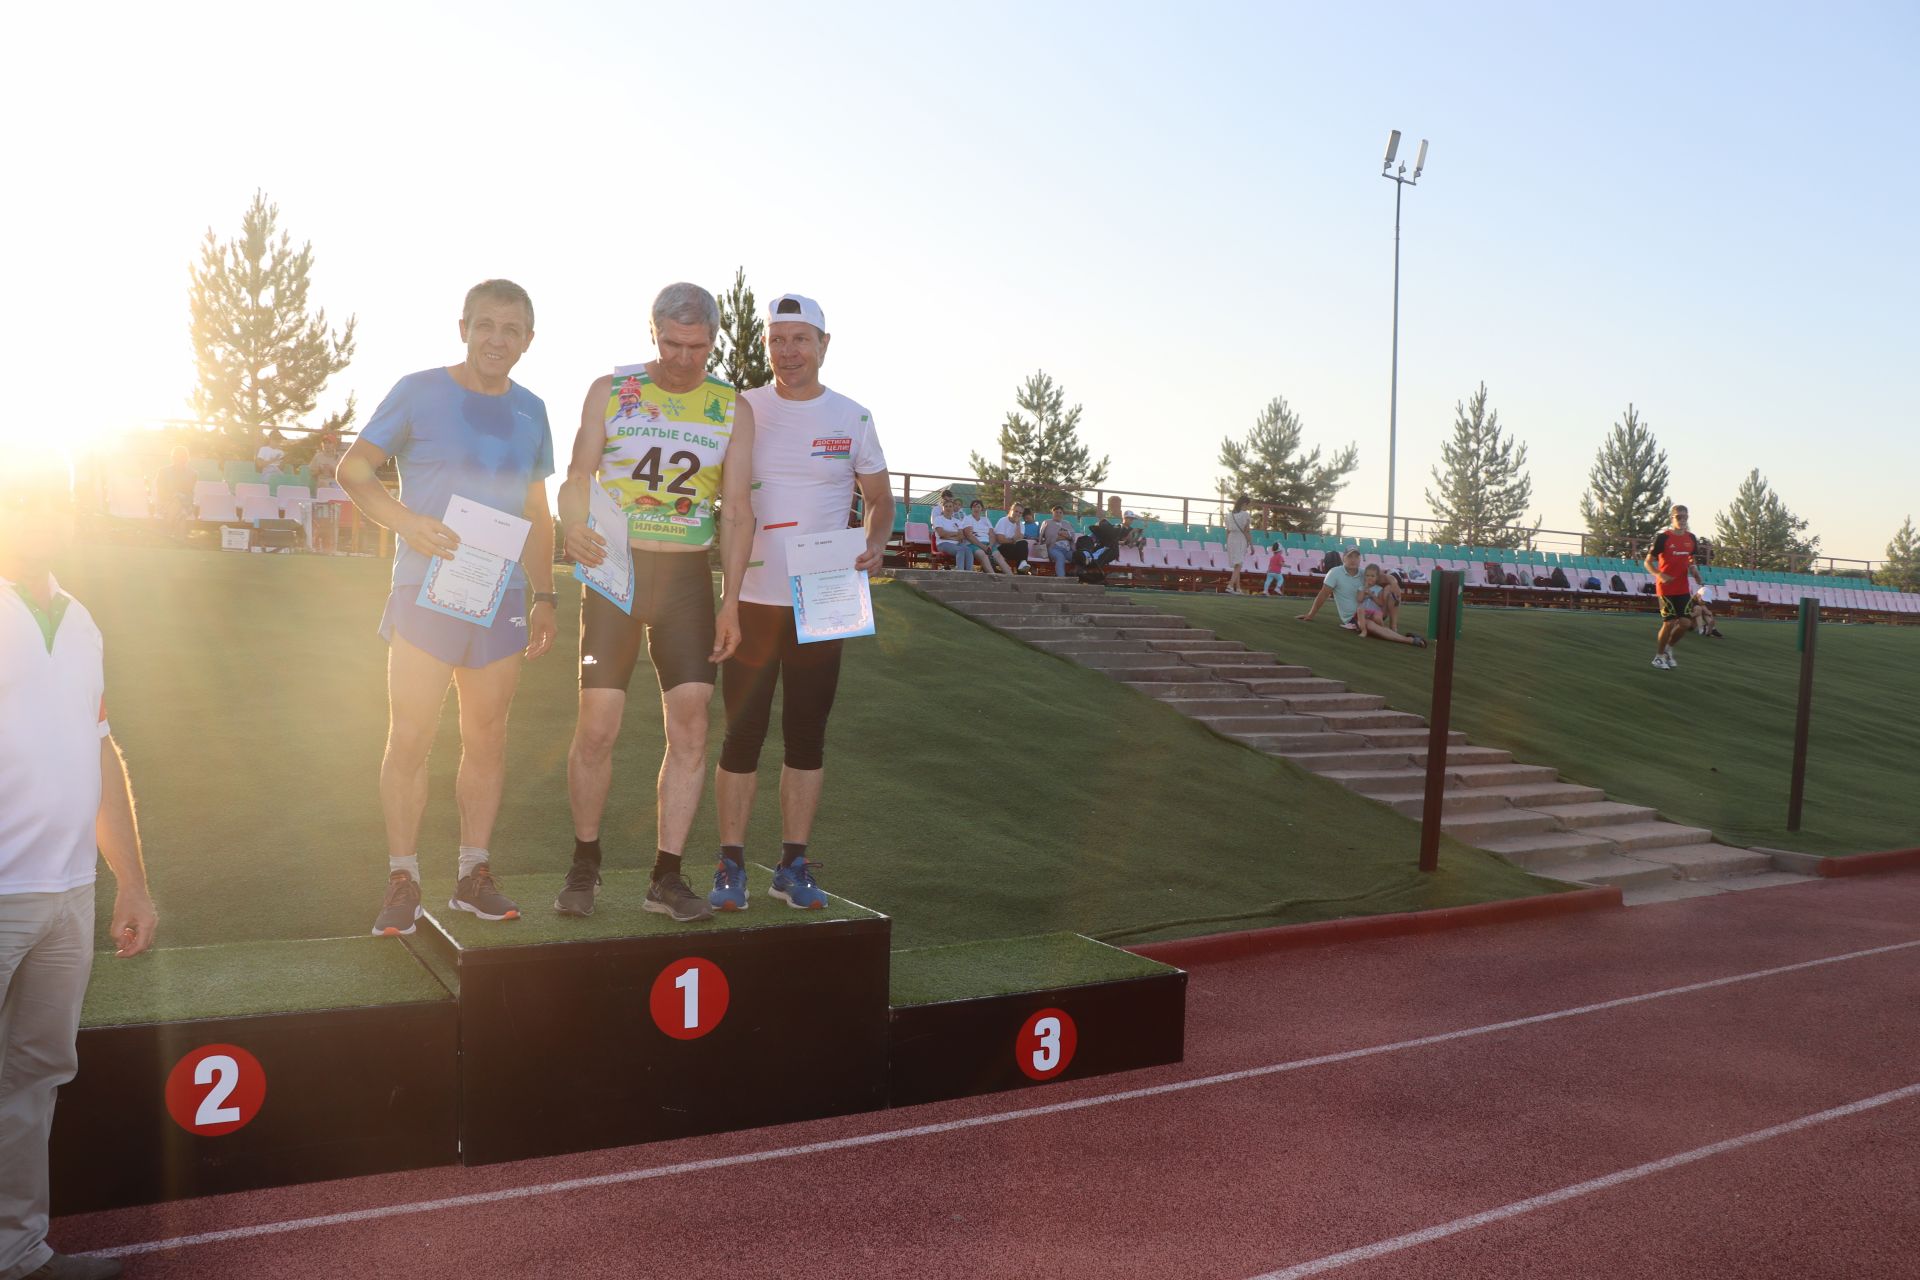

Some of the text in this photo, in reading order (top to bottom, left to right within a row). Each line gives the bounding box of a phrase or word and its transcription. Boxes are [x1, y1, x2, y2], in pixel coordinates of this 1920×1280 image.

[617, 426, 719, 450] БОГАТЫЕ САБЫ
[631, 446, 701, 496] 42
[634, 521, 686, 535] ИЛФАНИ
[675, 968, 699, 1028] 1
[1032, 1017, 1061, 1071] 3
[194, 1055, 240, 1125] 2
